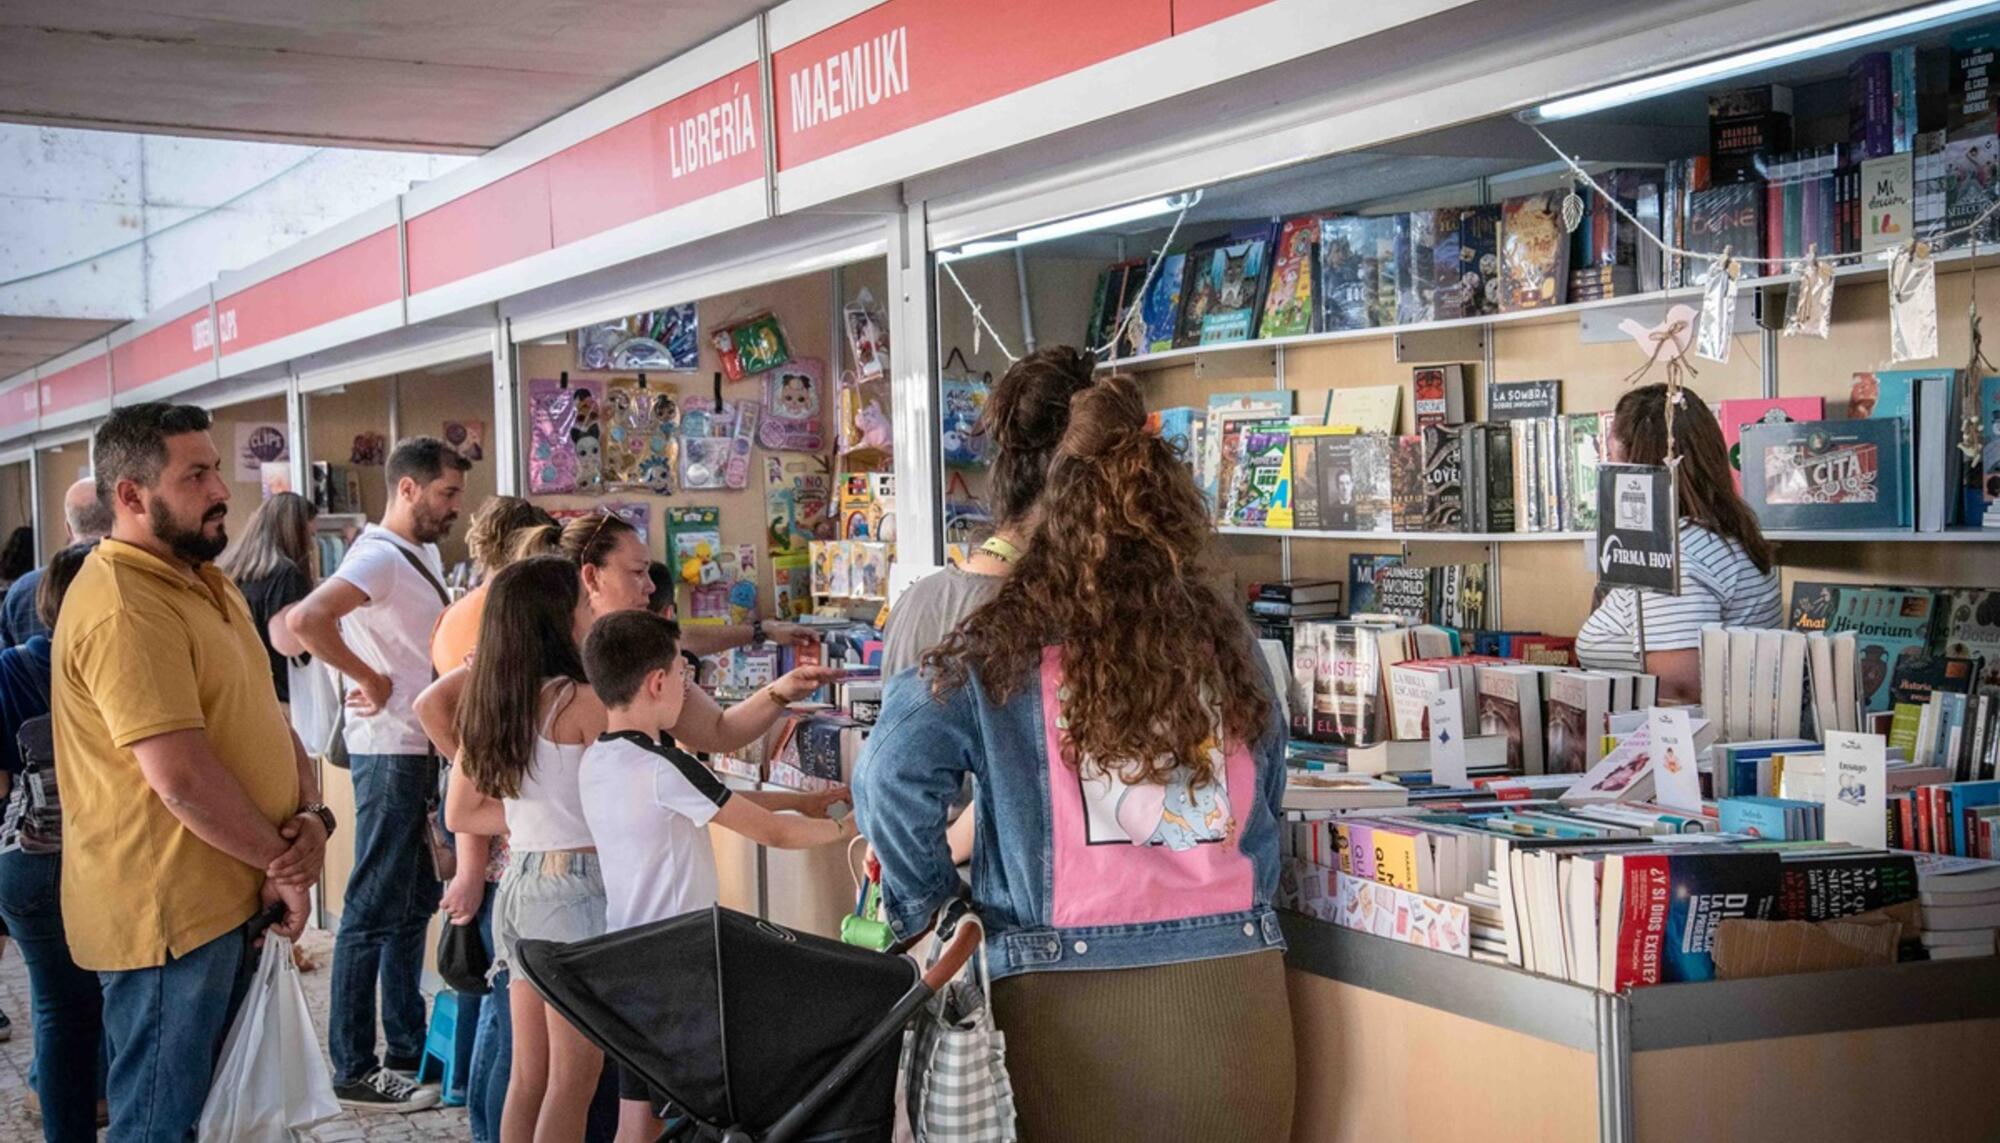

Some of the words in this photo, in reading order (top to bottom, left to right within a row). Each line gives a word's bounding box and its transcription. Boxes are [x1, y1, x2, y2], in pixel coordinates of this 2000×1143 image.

[789, 26, 910, 133] MAEMUKI
[668, 81, 757, 179] LIBRERÍA
[1493, 390, 1505, 402] LA
[1507, 389, 1548, 401] SOMBRA
[250, 432, 283, 449] CLIPS
[1426, 471, 1461, 484] LOVE
[1782, 467, 1808, 492] LA
[1812, 453, 1862, 484] CITA
[1612, 549, 1645, 567] FIRMA
[1649, 552, 1673, 569] HOY
[1380, 566, 1424, 580] GUINNESS
[1382, 580, 1424, 596] WORLD
[1382, 596, 1424, 608] RECORDS
[1834, 616, 1912, 638] Historium
[1320, 660, 1371, 679] MISTER
[1650, 867, 1665, 883] ¿Y
[1652, 887, 1665, 901] SI
[1710, 894, 1724, 909] LA
[1698, 895, 1709, 912] LAS
[1648, 904, 1664, 931] DIOS
[1691, 914, 1705, 953] PRUEBAS
[1642, 935, 1660, 985] EXISTE?
